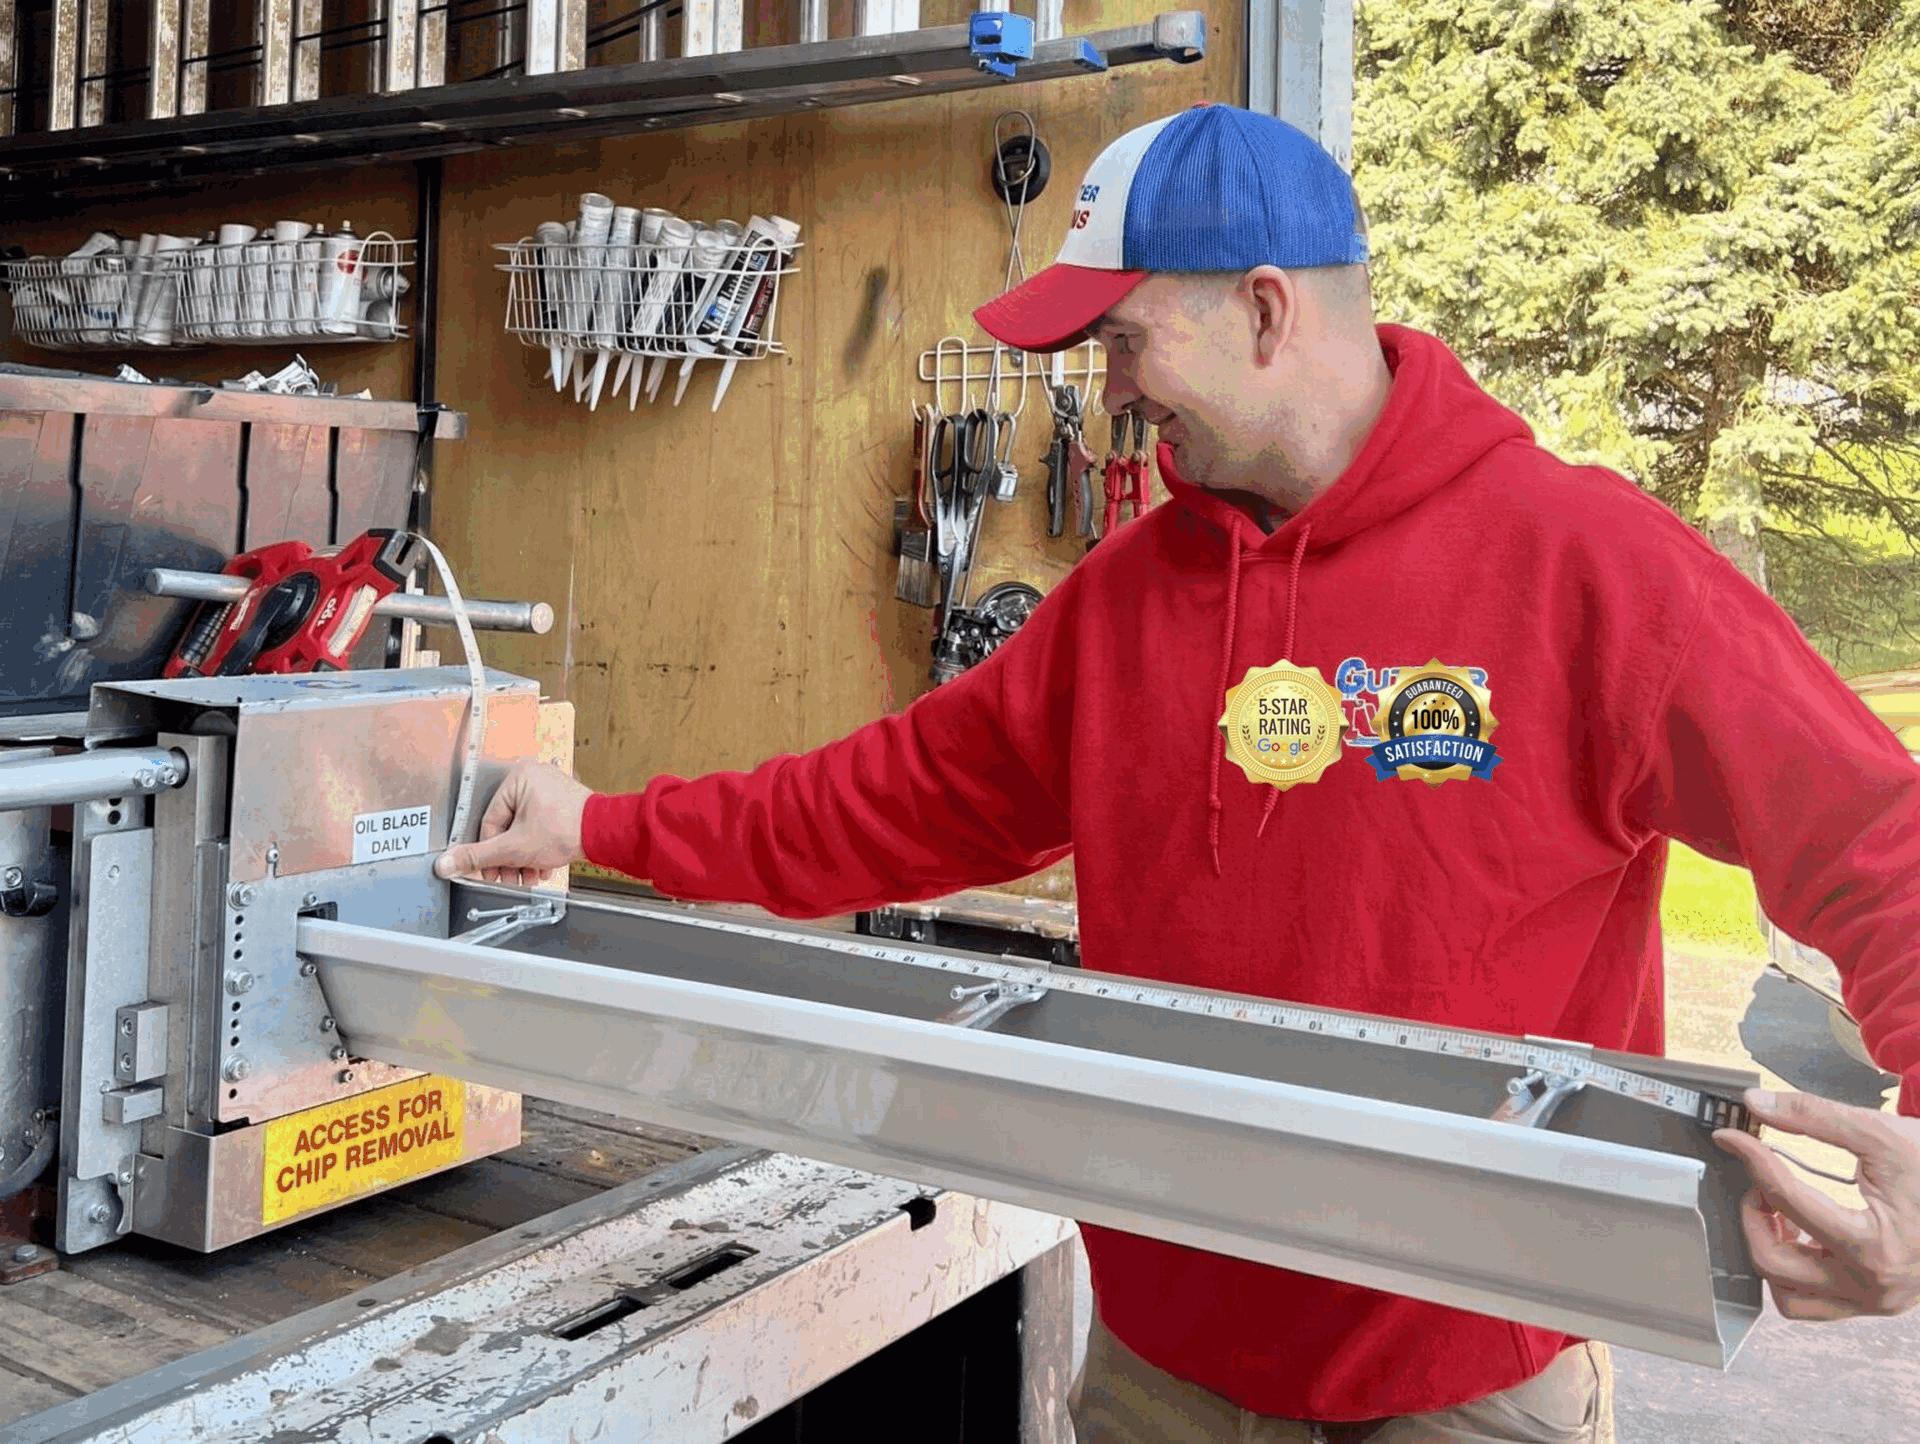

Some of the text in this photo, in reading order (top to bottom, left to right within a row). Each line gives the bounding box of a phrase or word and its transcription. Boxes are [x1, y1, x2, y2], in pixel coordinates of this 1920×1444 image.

[356, 812, 428, 834] OIL BLADE
[372, 835, 411, 855] DAILY
[1170, 999, 1178, 1007] 2
[1272, 1014, 1285, 1025] 11
[1308, 1020, 1323, 1032] 10
[1358, 1028, 1367, 1038] 9
[1400, 1035, 1408, 1045] 8
[1440, 1041, 1448, 1051] 7
[1484, 1048, 1492, 1058] 6
[1527, 1055, 1536, 1065] 5
[1573, 1067, 1581, 1076] 4
[1619, 1081, 1628, 1092] 3
[1665, 1095, 1674, 1106] 2
[294, 1090, 442, 1156] ACCESS FOR
[277, 1117, 455, 1193] CHIP REMOVAL
